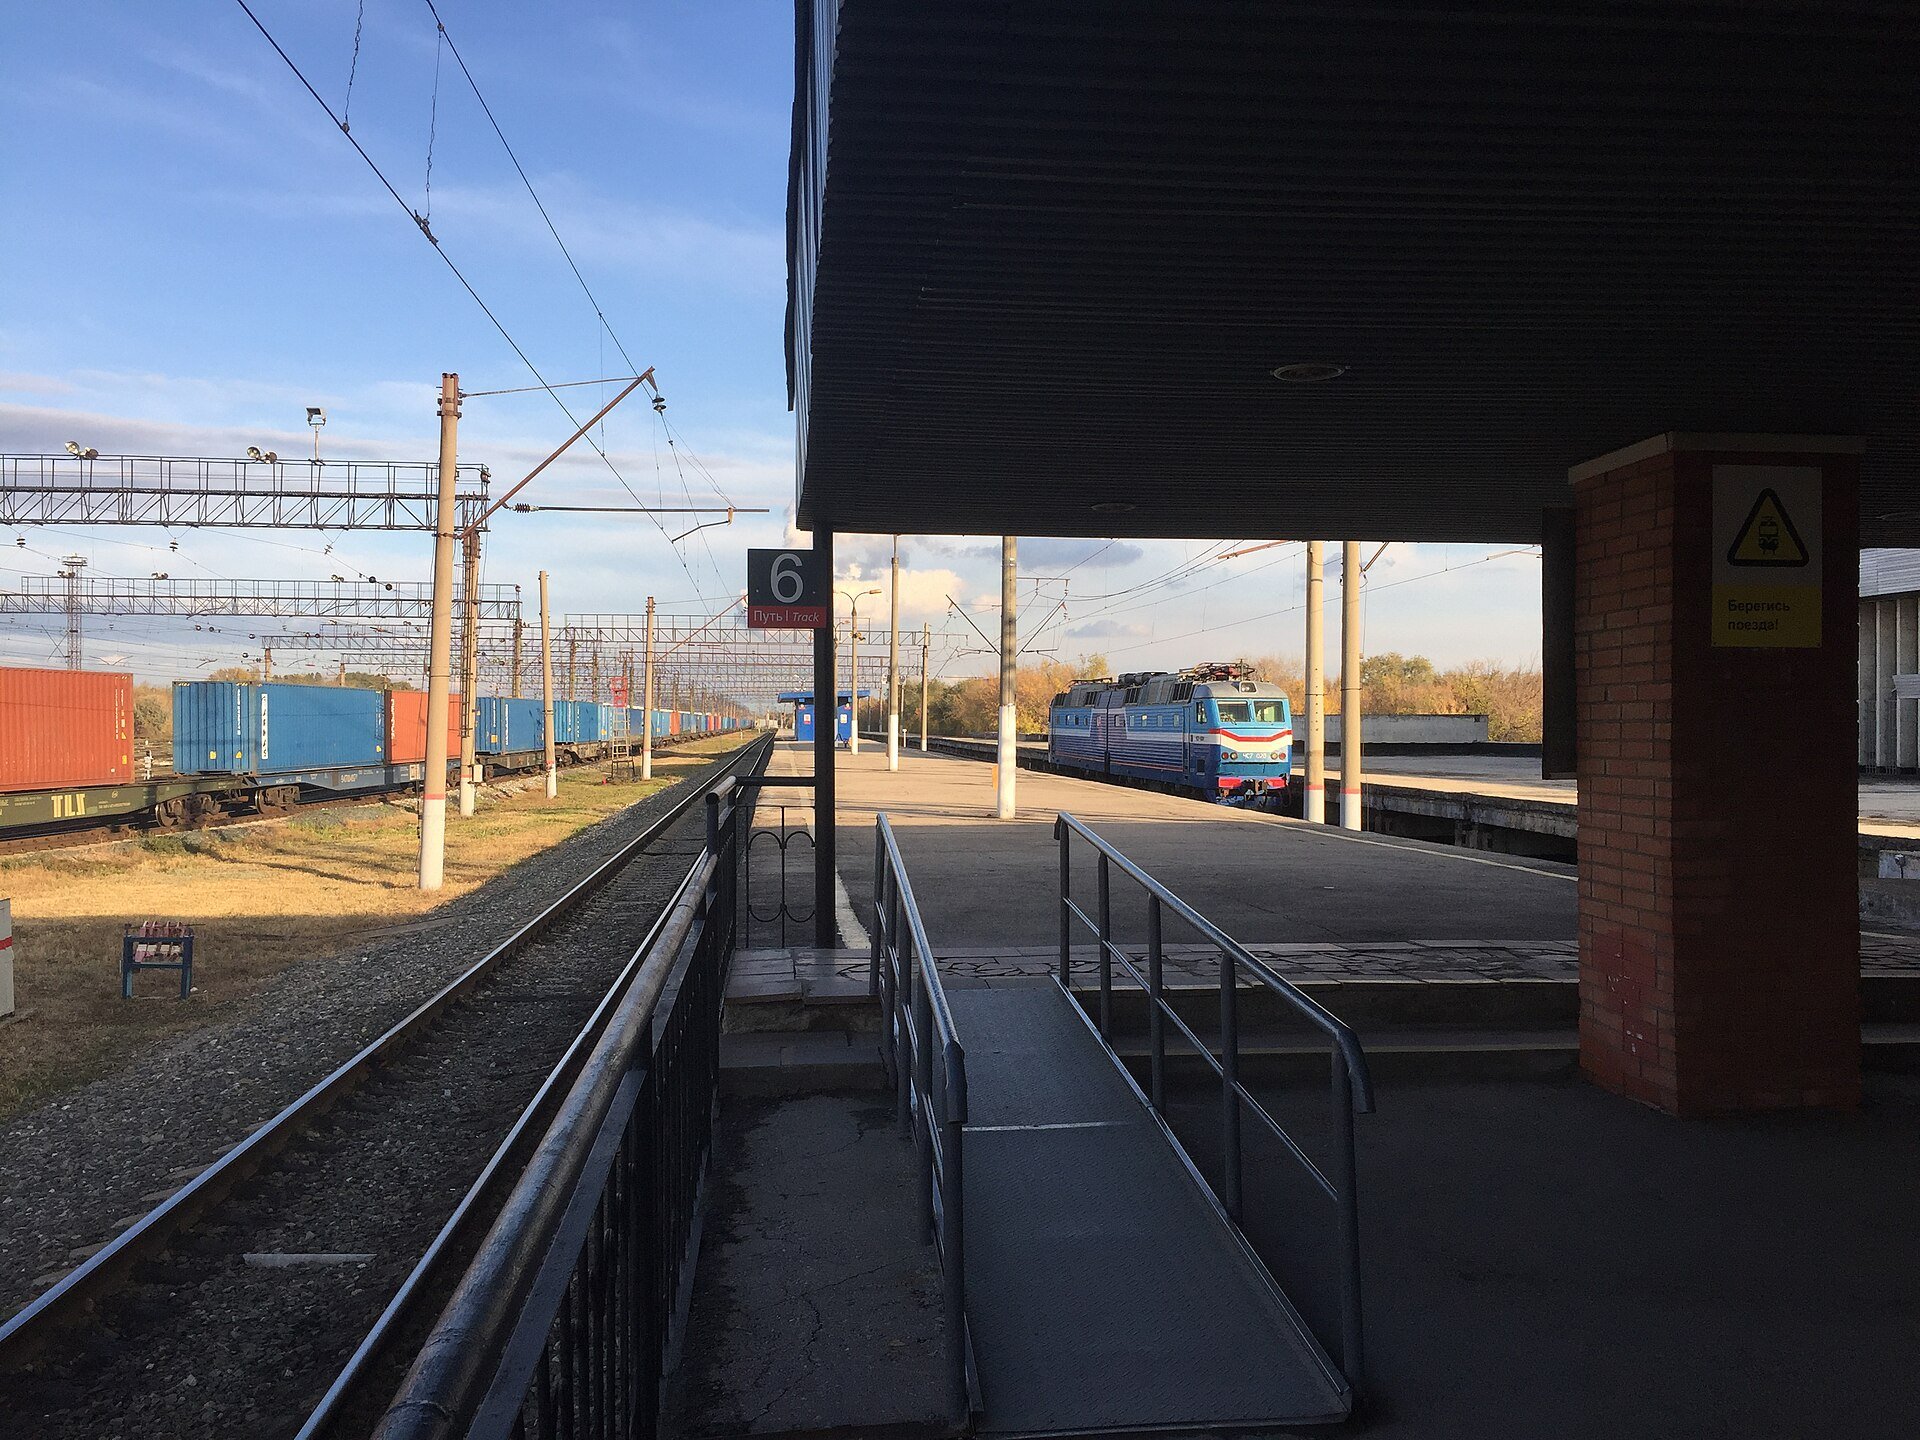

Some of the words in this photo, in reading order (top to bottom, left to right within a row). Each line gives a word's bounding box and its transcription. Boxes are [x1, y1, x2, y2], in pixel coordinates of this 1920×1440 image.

[771, 553, 803, 603] 6
[1728, 599, 1790, 614] Берегись
[754, 610, 783, 625] Путь
[793, 612, 820, 622] Track
[1728, 619, 1778, 631] поезда!
